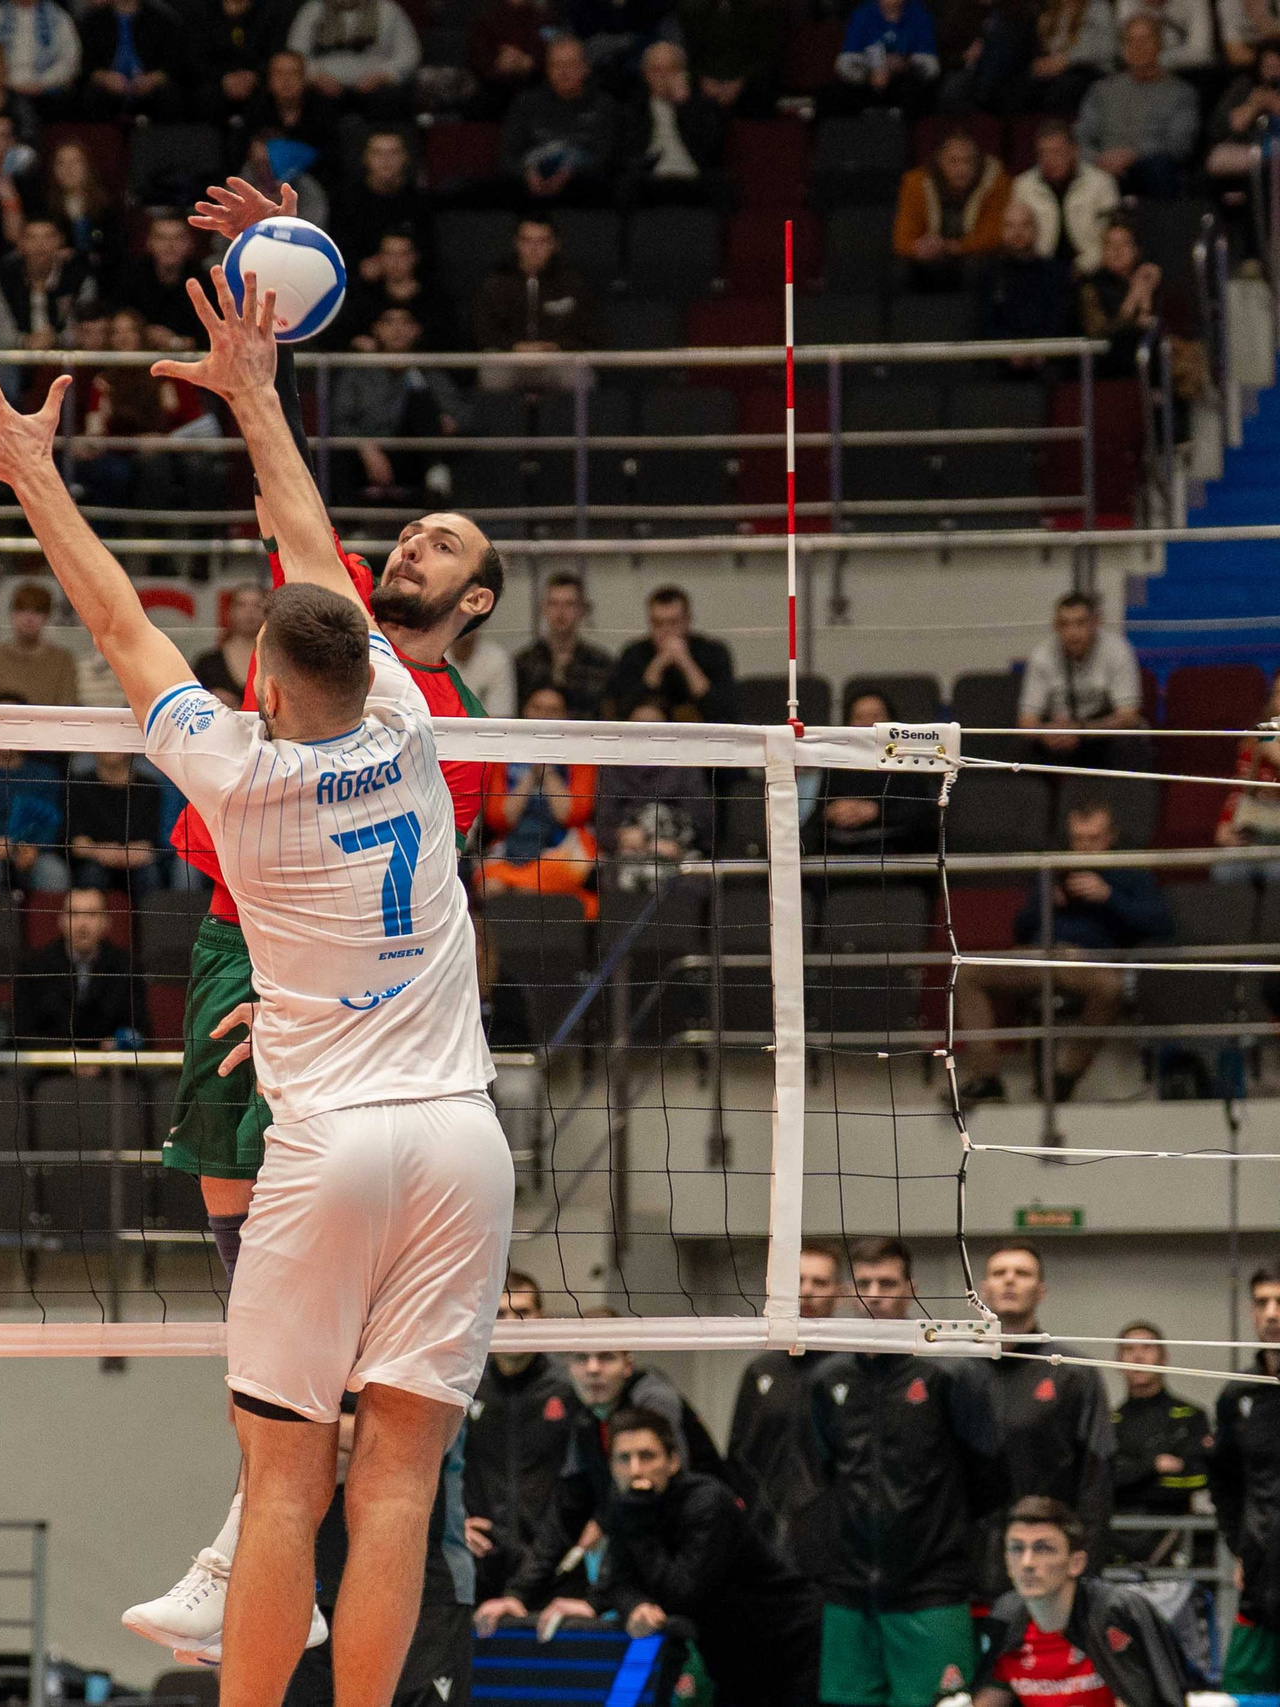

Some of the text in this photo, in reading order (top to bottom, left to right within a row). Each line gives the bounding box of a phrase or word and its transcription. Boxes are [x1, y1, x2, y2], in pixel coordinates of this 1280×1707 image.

[900, 729, 940, 741] Senoh
[329, 810, 421, 937] 7
[378, 947, 424, 961] ENSEN
